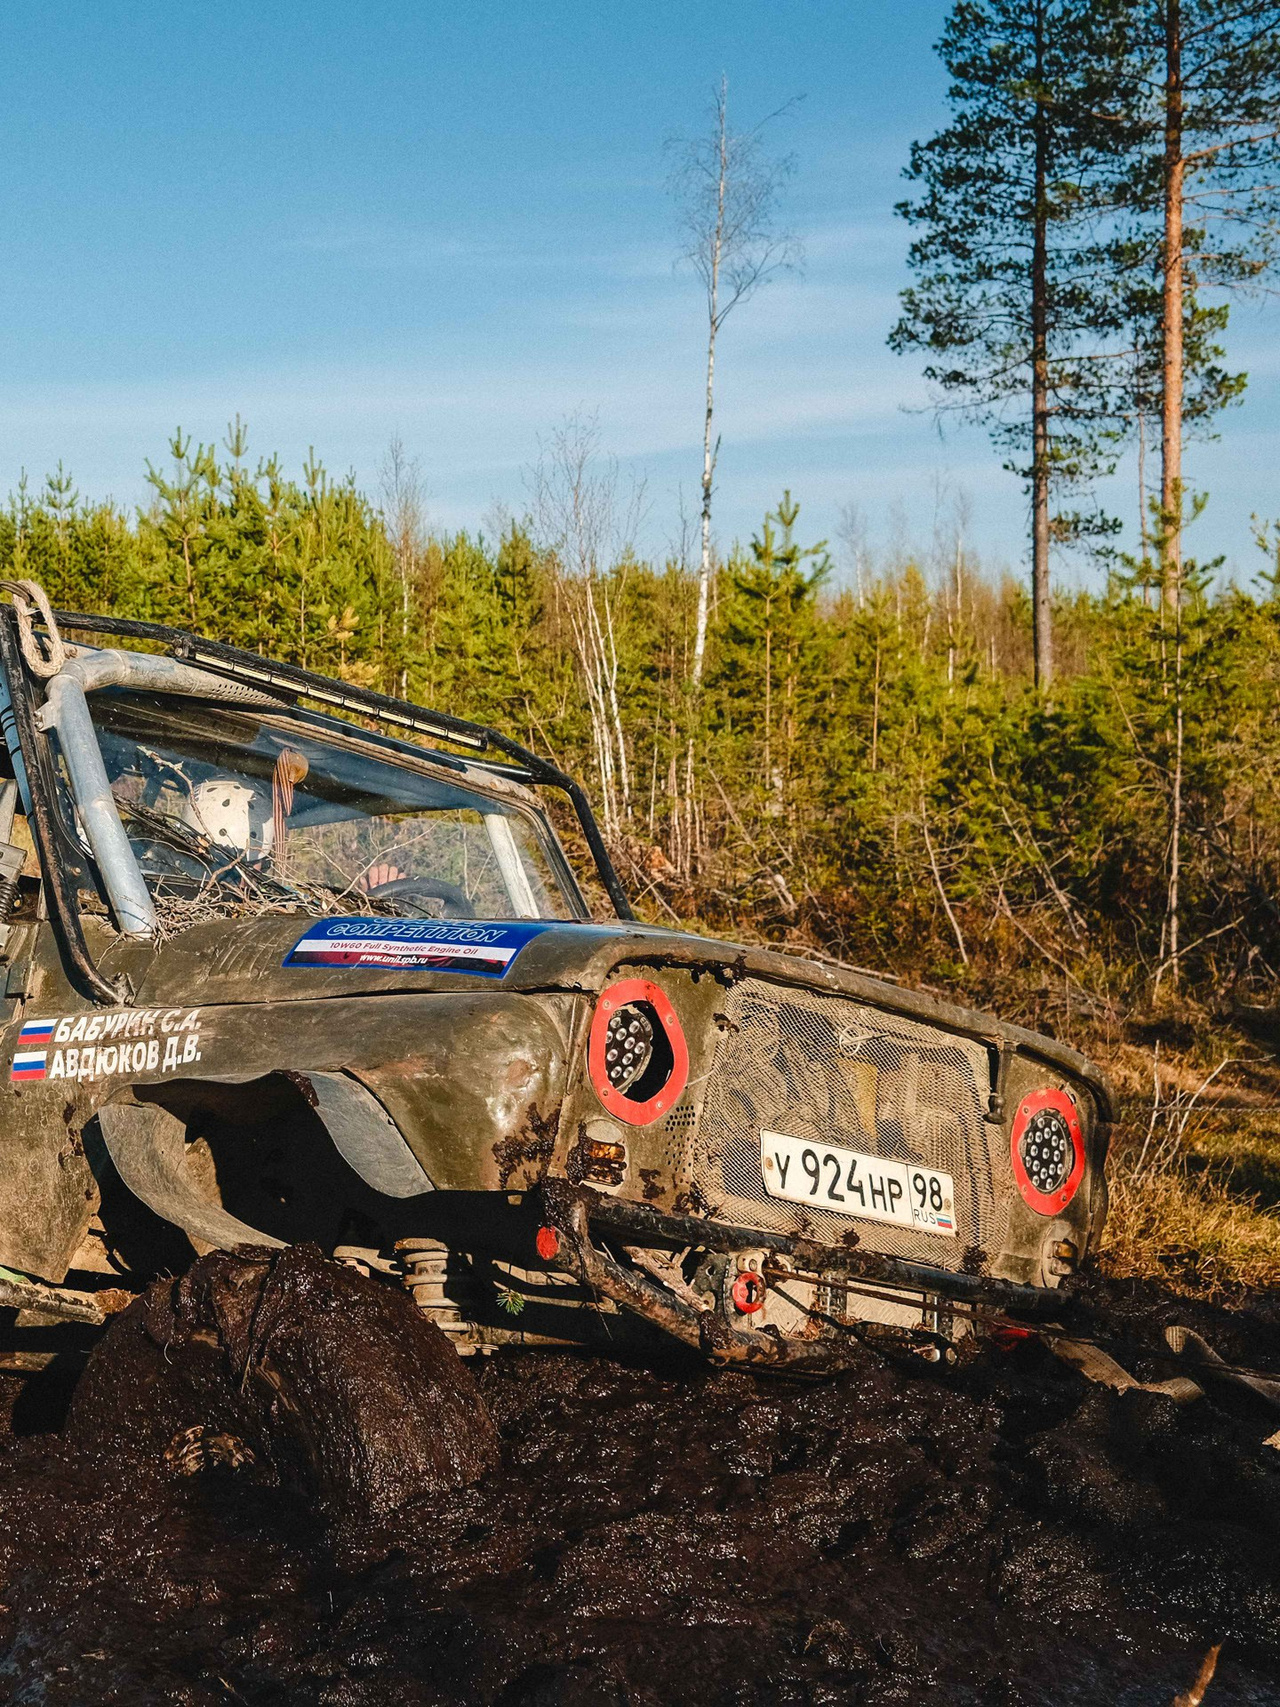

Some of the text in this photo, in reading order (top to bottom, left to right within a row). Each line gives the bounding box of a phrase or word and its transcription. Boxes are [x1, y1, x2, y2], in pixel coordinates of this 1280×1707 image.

[327, 923, 507, 943] COMPETITION
[382, 943, 426, 951] Synthetic
[428, 945, 461, 954] Engine
[54, 1009, 201, 1043] БАБУРИН С.А.
[49, 1034, 201, 1082] АВДЮКОВ Д.В.
[913, 1173, 943, 1211] 98
[913, 1209, 936, 1225] RUS
